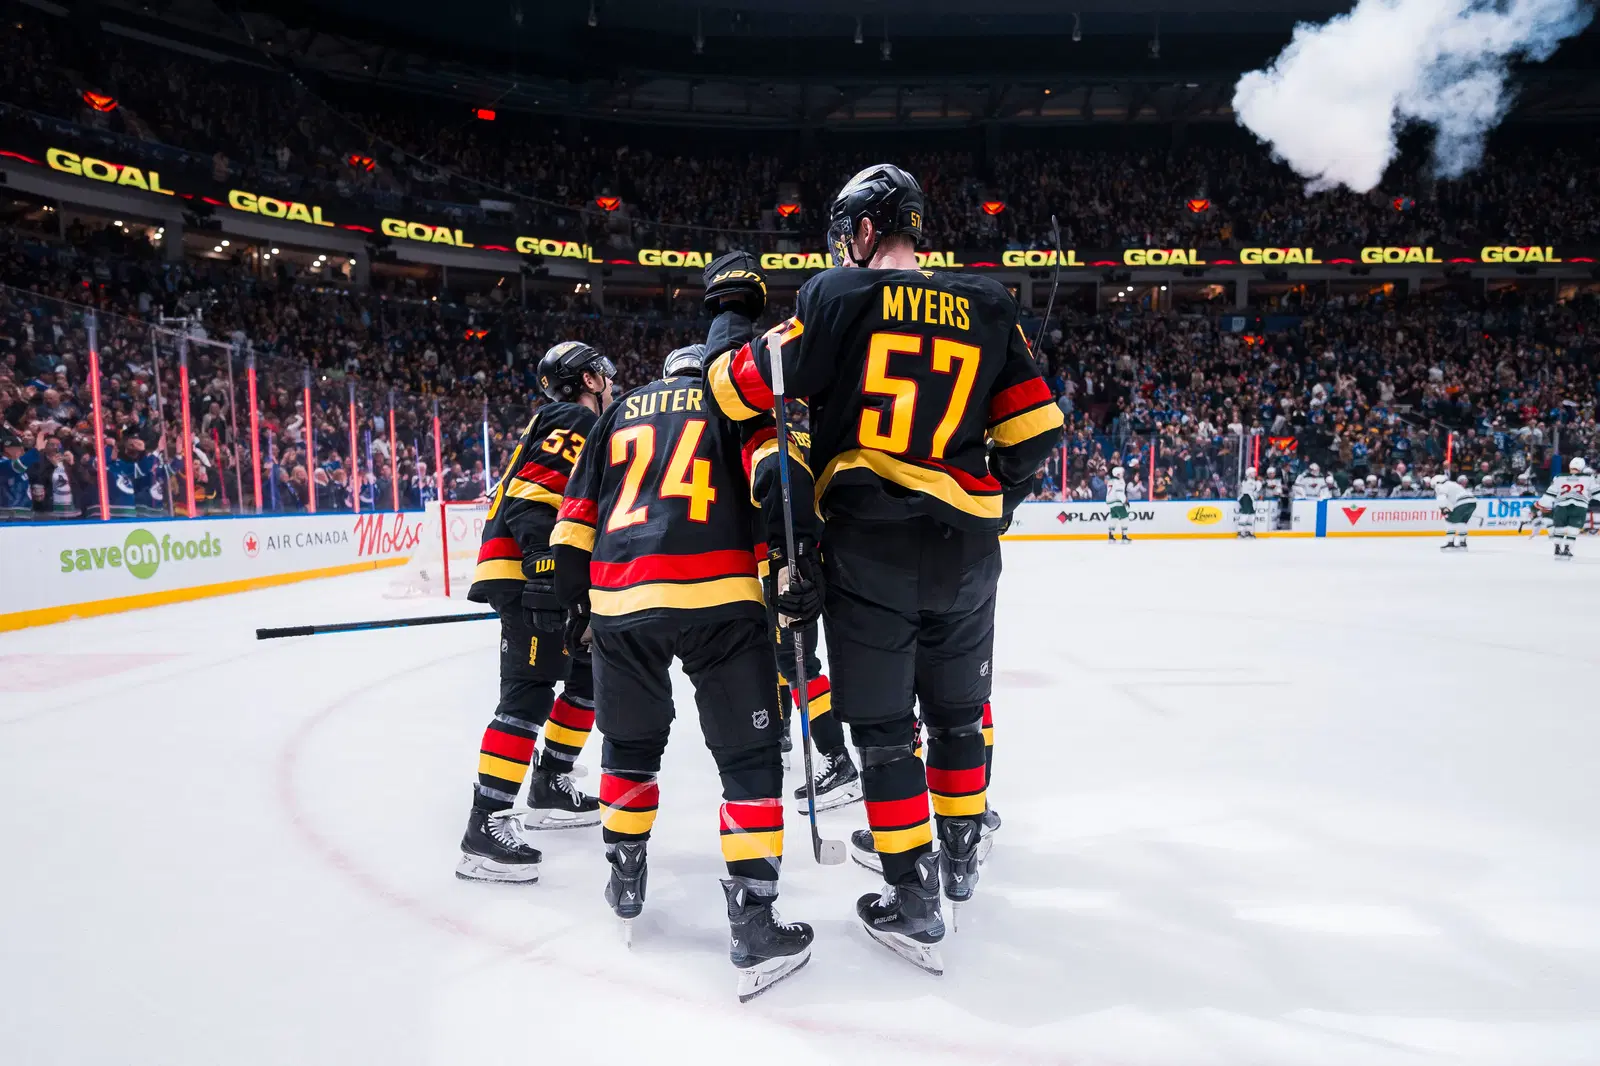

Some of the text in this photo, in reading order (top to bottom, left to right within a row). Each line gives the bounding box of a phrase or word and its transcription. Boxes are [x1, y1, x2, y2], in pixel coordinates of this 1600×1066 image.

[46, 148, 175, 196] GOAL
[228, 189, 335, 227] GOAL
[381, 218, 474, 248] GOAL
[516, 236, 603, 264] GOAL
[1002, 250, 1085, 267] GOAL
[1123, 249, 1206, 265] GOAL
[1239, 248, 1322, 265] GOAL
[1361, 247, 1443, 264] GOAL
[1481, 246, 1562, 263] GOAL
[883, 285, 970, 331] MYERS
[625, 388, 703, 420] SUTER
[857, 330, 982, 460] 57
[541, 428, 586, 464] 53
[606, 419, 717, 534] 24
[1067, 511, 1155, 522] PLAYOW
[1371, 511, 1427, 522] CANADIAN
[60, 546, 122, 573] save
[161, 532, 222, 561] foods
[267, 530, 349, 550] AIR CANADA
[529, 636, 538, 666] CCM
[874, 914, 898, 925] BAUER
